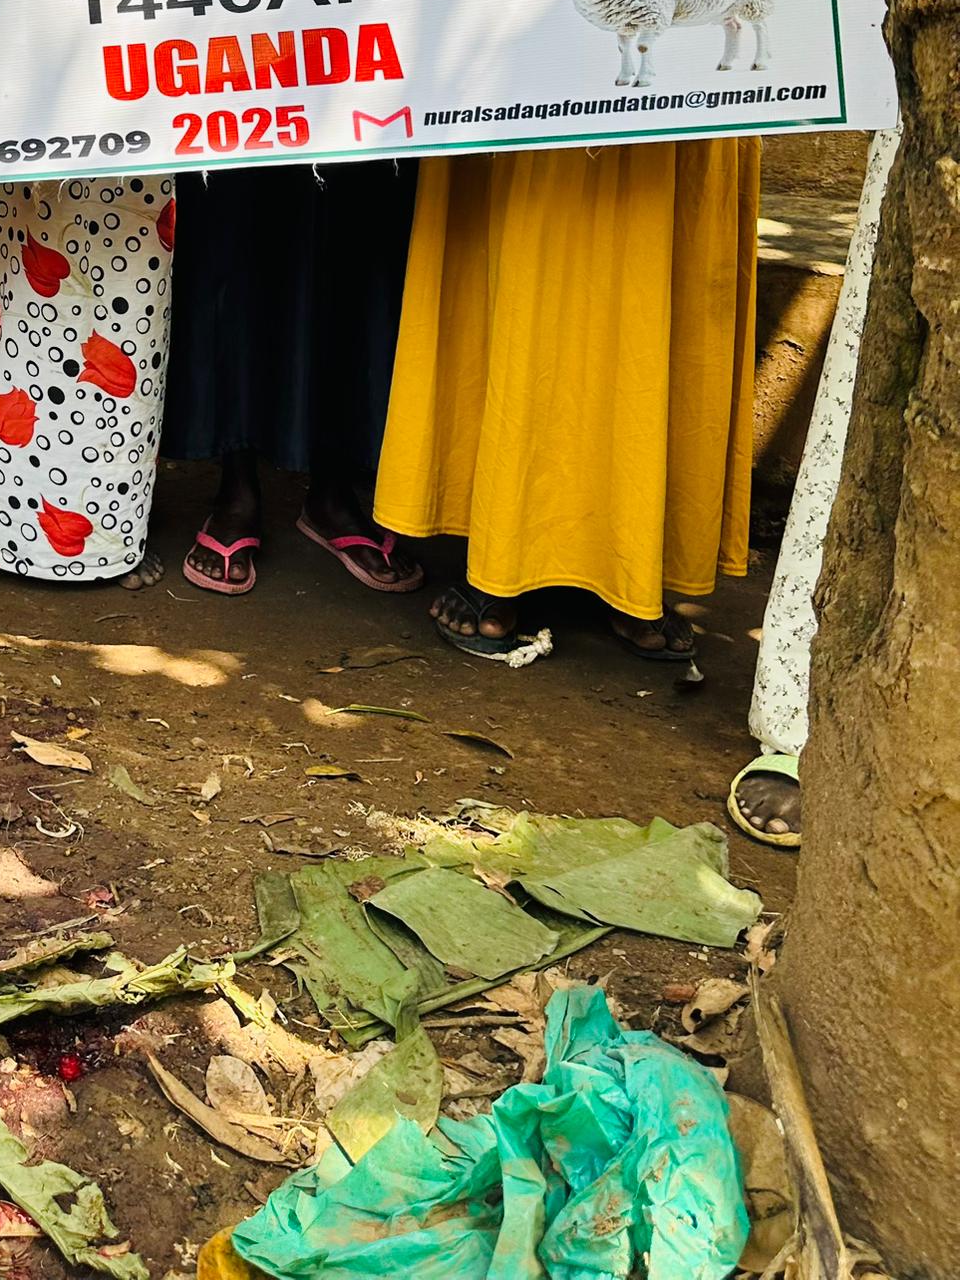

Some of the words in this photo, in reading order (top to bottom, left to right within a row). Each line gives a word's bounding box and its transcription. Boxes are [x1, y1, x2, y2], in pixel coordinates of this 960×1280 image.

[102, 22, 404, 102] UGANDA
[171, 104, 310, 155] 2025
[423, 84, 828, 126] nuralsadaqafoundation@gmail.com
